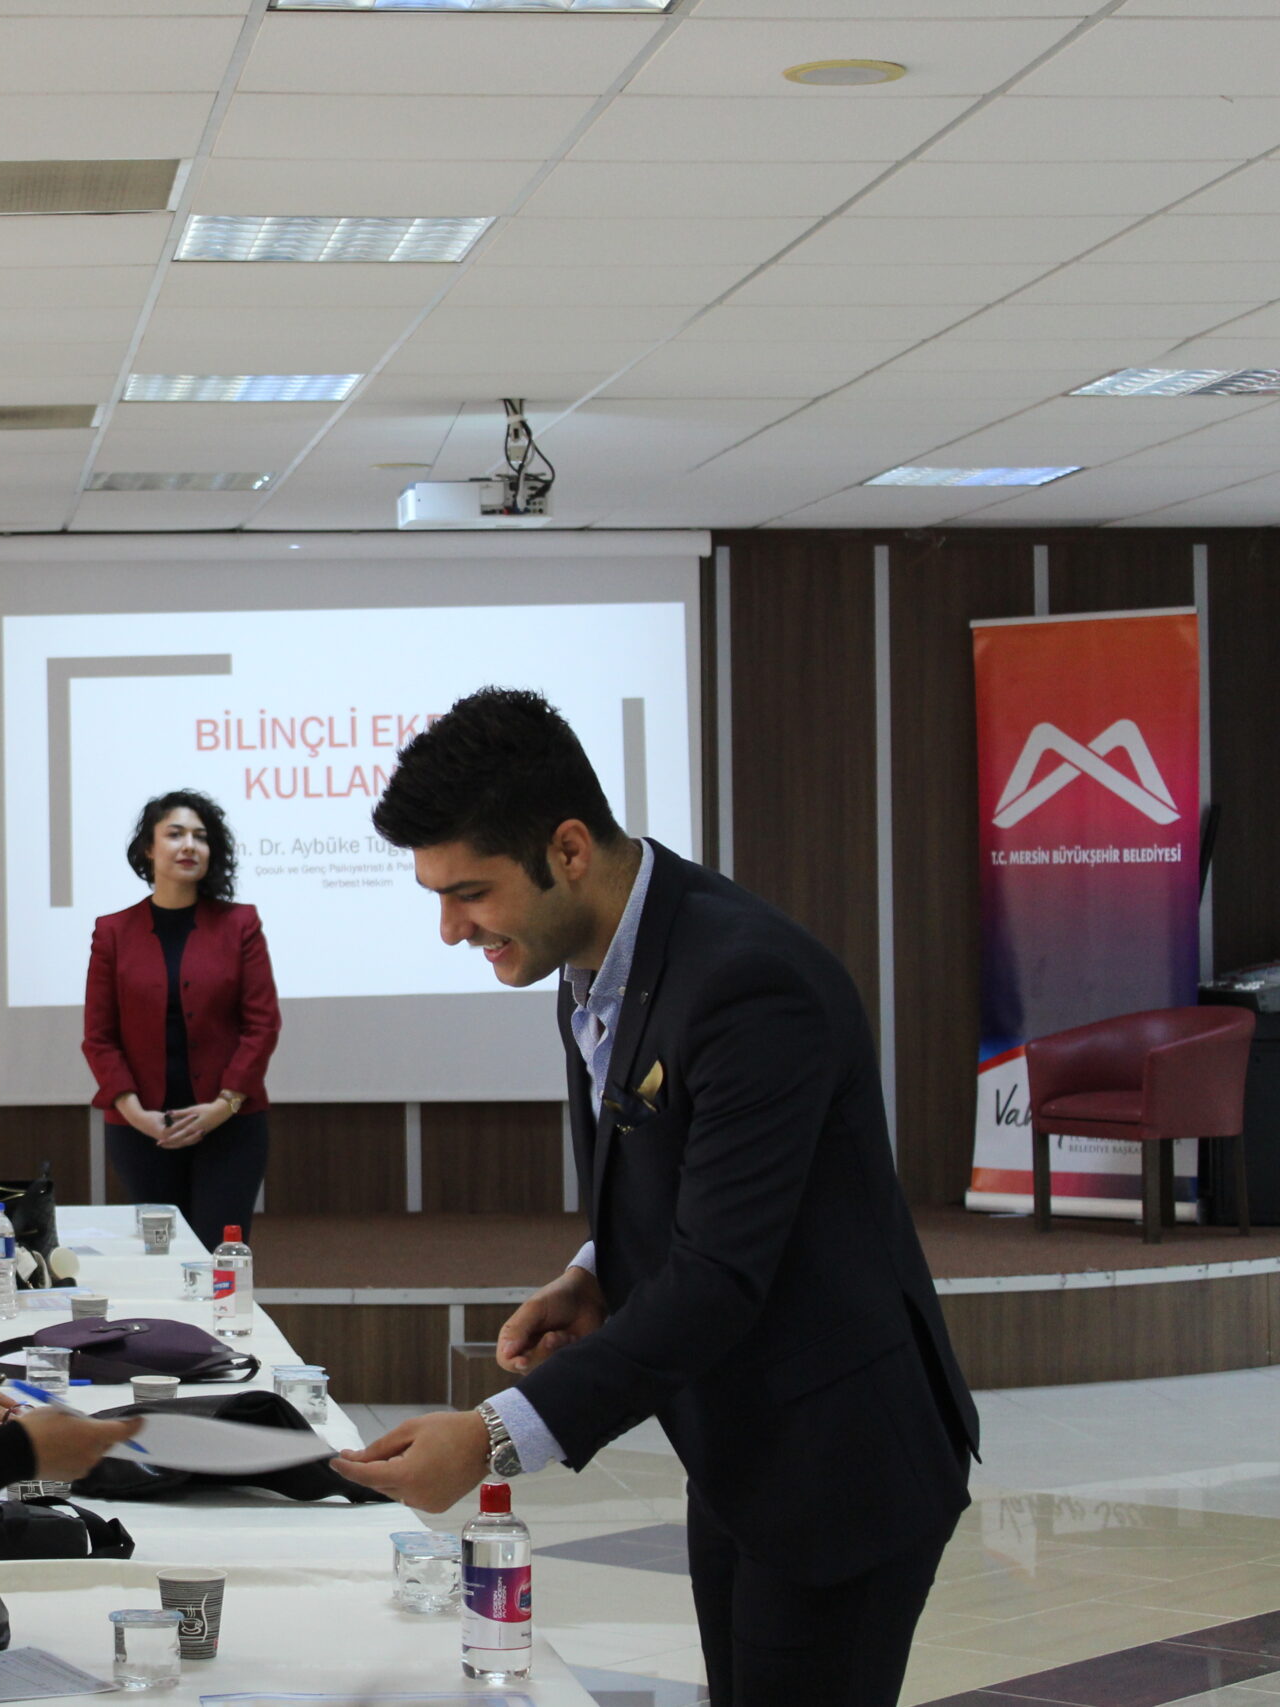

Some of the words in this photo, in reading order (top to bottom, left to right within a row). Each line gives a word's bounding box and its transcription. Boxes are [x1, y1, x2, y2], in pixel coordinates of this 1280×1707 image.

[195, 706, 357, 758] BİLİNÇLİ
[372, 713, 446, 747] EK
[260, 838, 286, 855] Dr.
[291, 836, 360, 858] Aybüke
[991, 851, 1007, 865] T.C.
[1009, 846, 1050, 864] MERSİN
[1052, 845, 1120, 867] BÜYÜKŞEHİR
[1123, 843, 1181, 863] BELEDİYESİ
